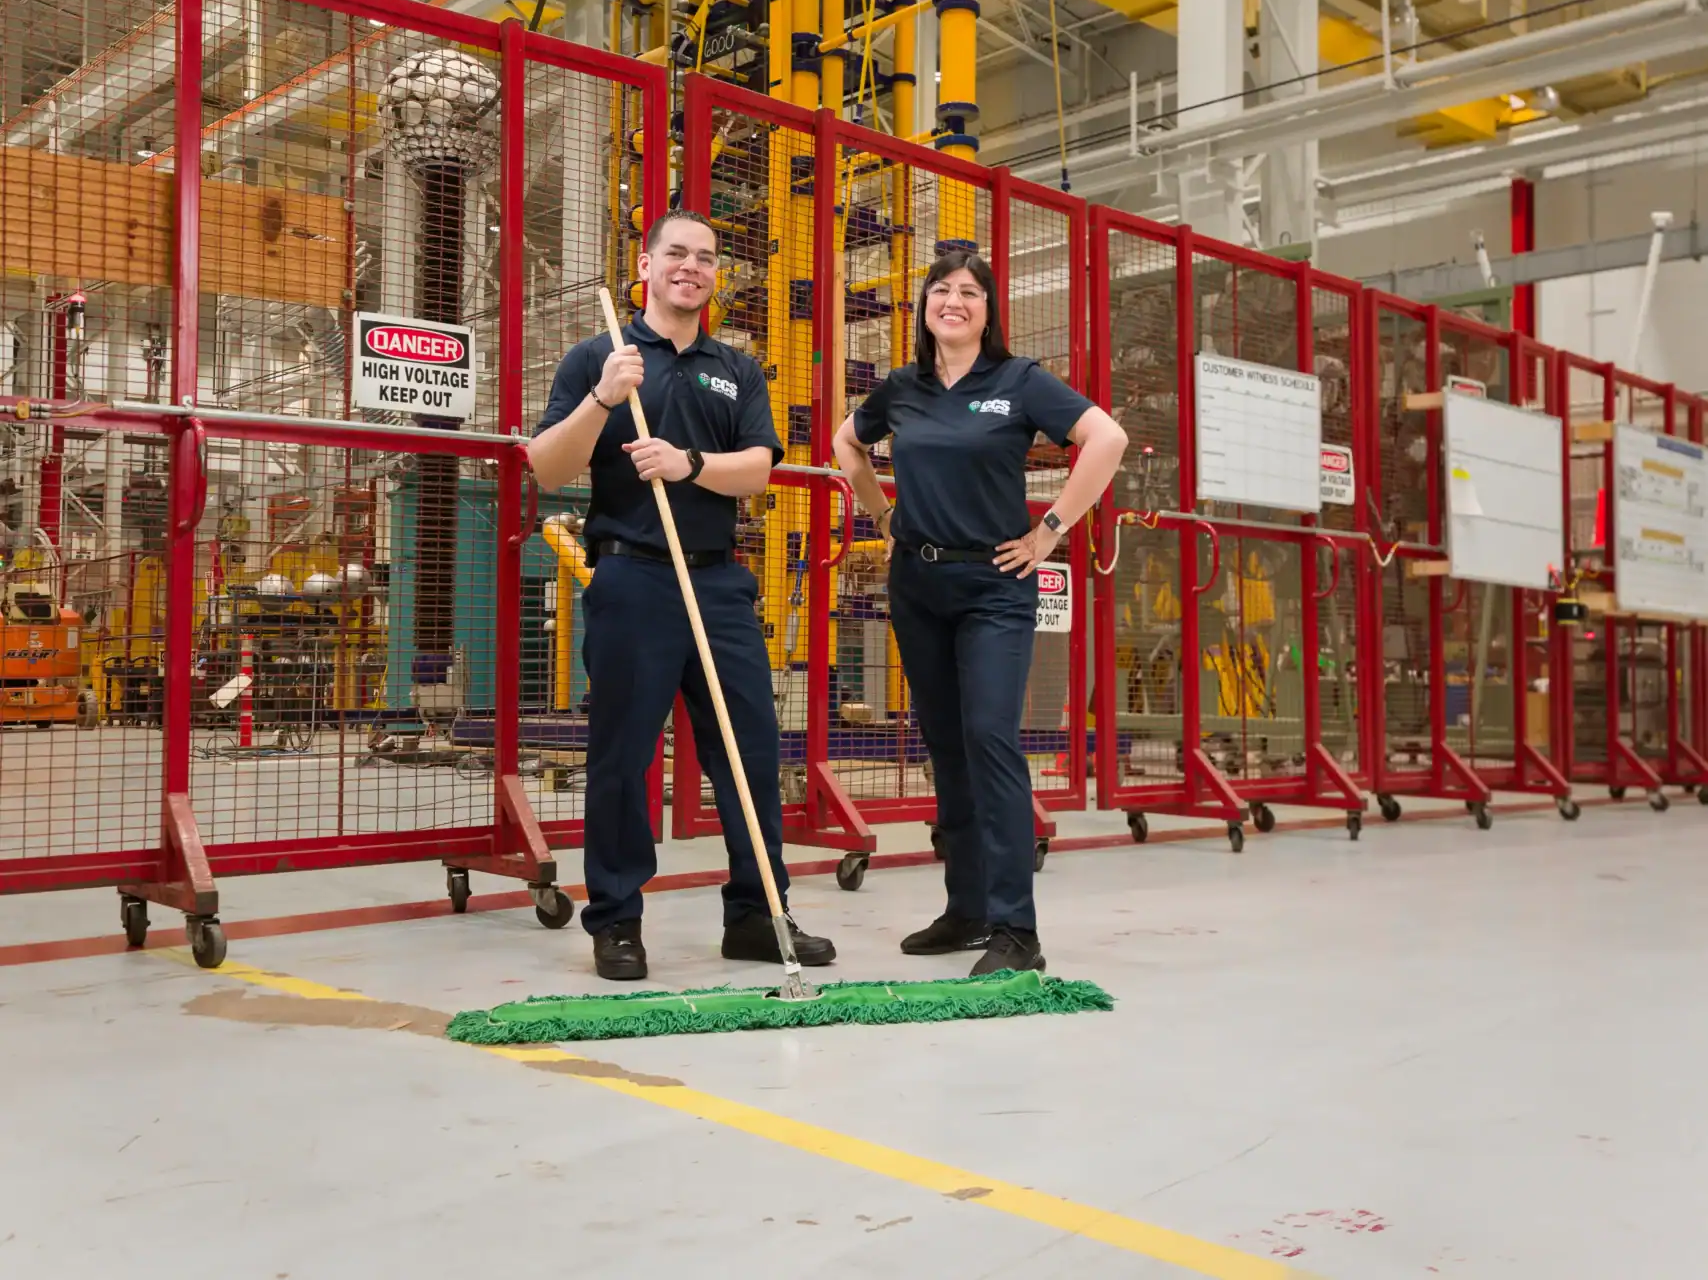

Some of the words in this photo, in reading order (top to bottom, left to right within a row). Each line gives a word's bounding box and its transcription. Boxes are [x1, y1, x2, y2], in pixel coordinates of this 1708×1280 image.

[704, 32, 735, 58] 6000
[373, 330, 458, 359] DANGER
[362, 361, 399, 381] HIGH
[404, 366, 469, 389] VOLTAGE
[710, 376, 738, 397] CCS
[1202, 362, 1244, 378] CUSTOMER
[1246, 371, 1279, 386] WITNESS
[1280, 376, 1316, 392] SCHEDULE
[379, 385, 418, 404] KEEP
[422, 390, 453, 408] OUT
[980, 398, 1011, 412] CCS
[1040, 598, 1069, 611] OLTAGE
[1044, 614, 1061, 626] OUT
